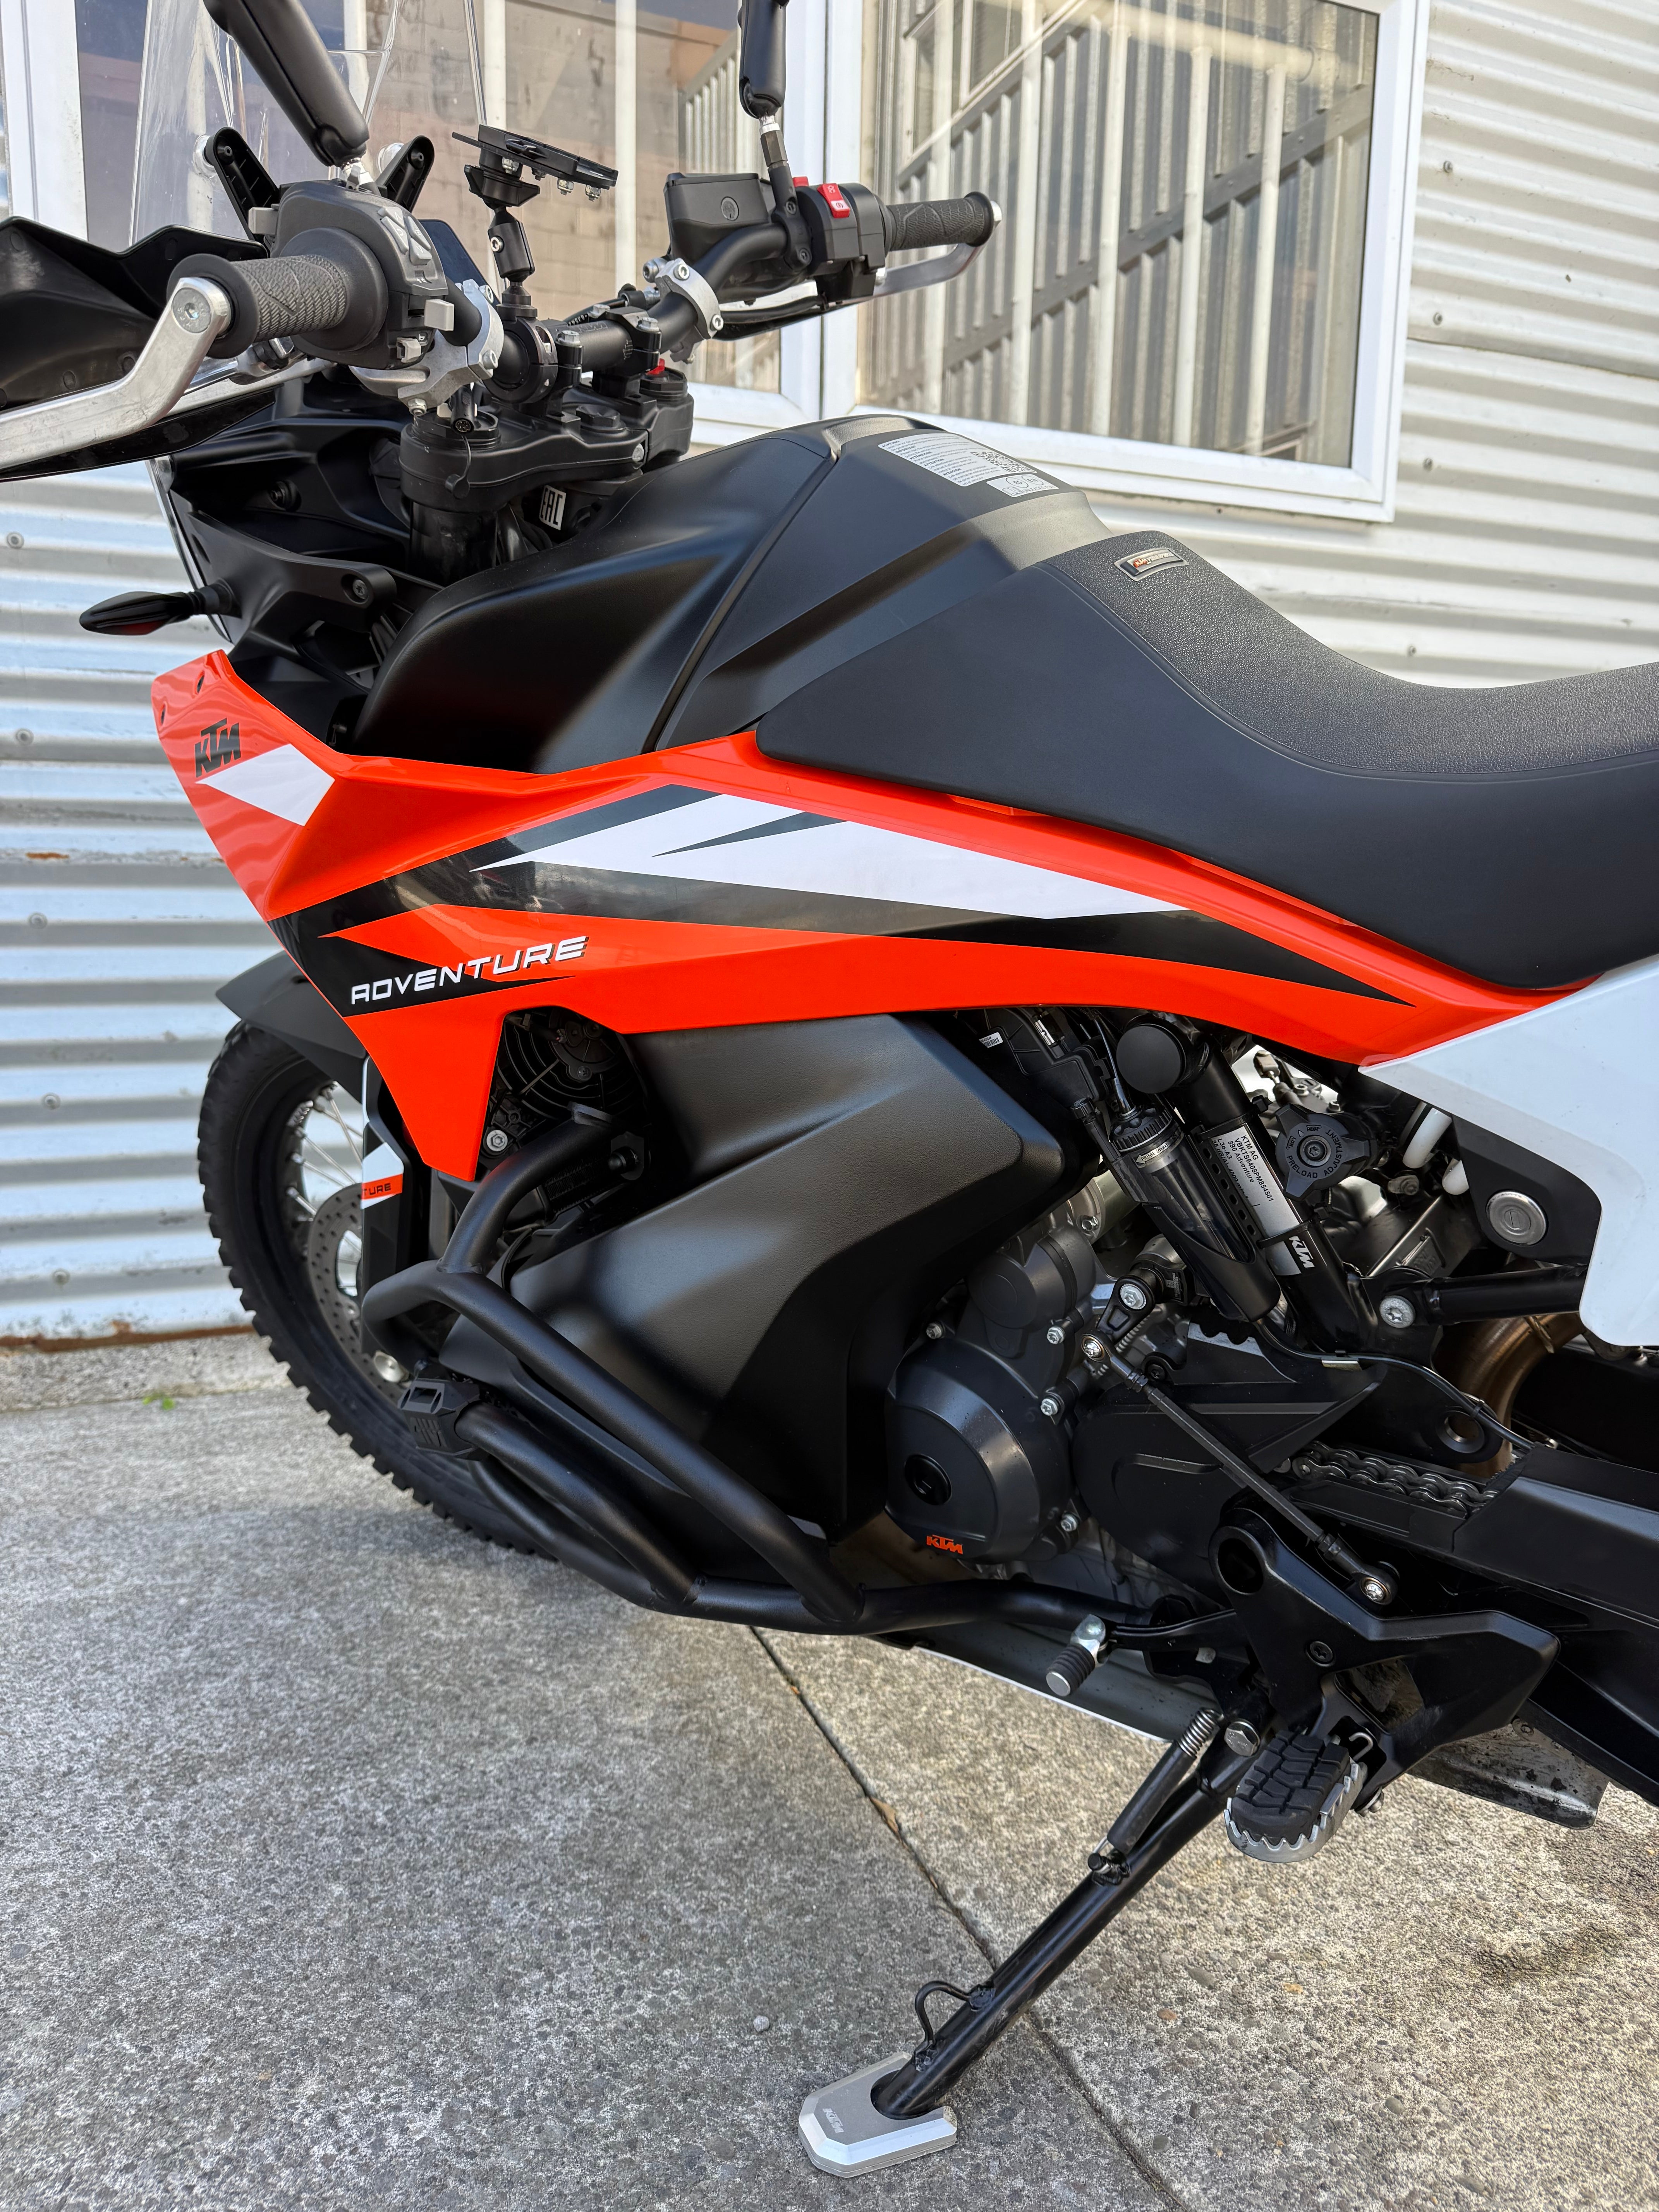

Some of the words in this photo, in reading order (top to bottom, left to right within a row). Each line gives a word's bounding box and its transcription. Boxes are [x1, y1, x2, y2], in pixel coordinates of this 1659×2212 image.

[194, 718, 241, 778] KTM
[351, 935, 589, 1005] ADVENTURE
[1142, 1152, 1155, 1161] PRIME
[1228, 1141, 1237, 1152] 890
[1235, 1152, 1254, 1183] Adventure
[1241, 1135, 1252, 1149] KTM
[1249, 1151, 1259, 1160] AG
[1286, 1155, 1318, 1178] PRELOAD
[1323, 1129, 1343, 1176] ADJUSTMENT
[1289, 1236, 1315, 1268] KTM
[926, 1534, 963, 1554] KTM
[822, 2108, 844, 2133] KTM
